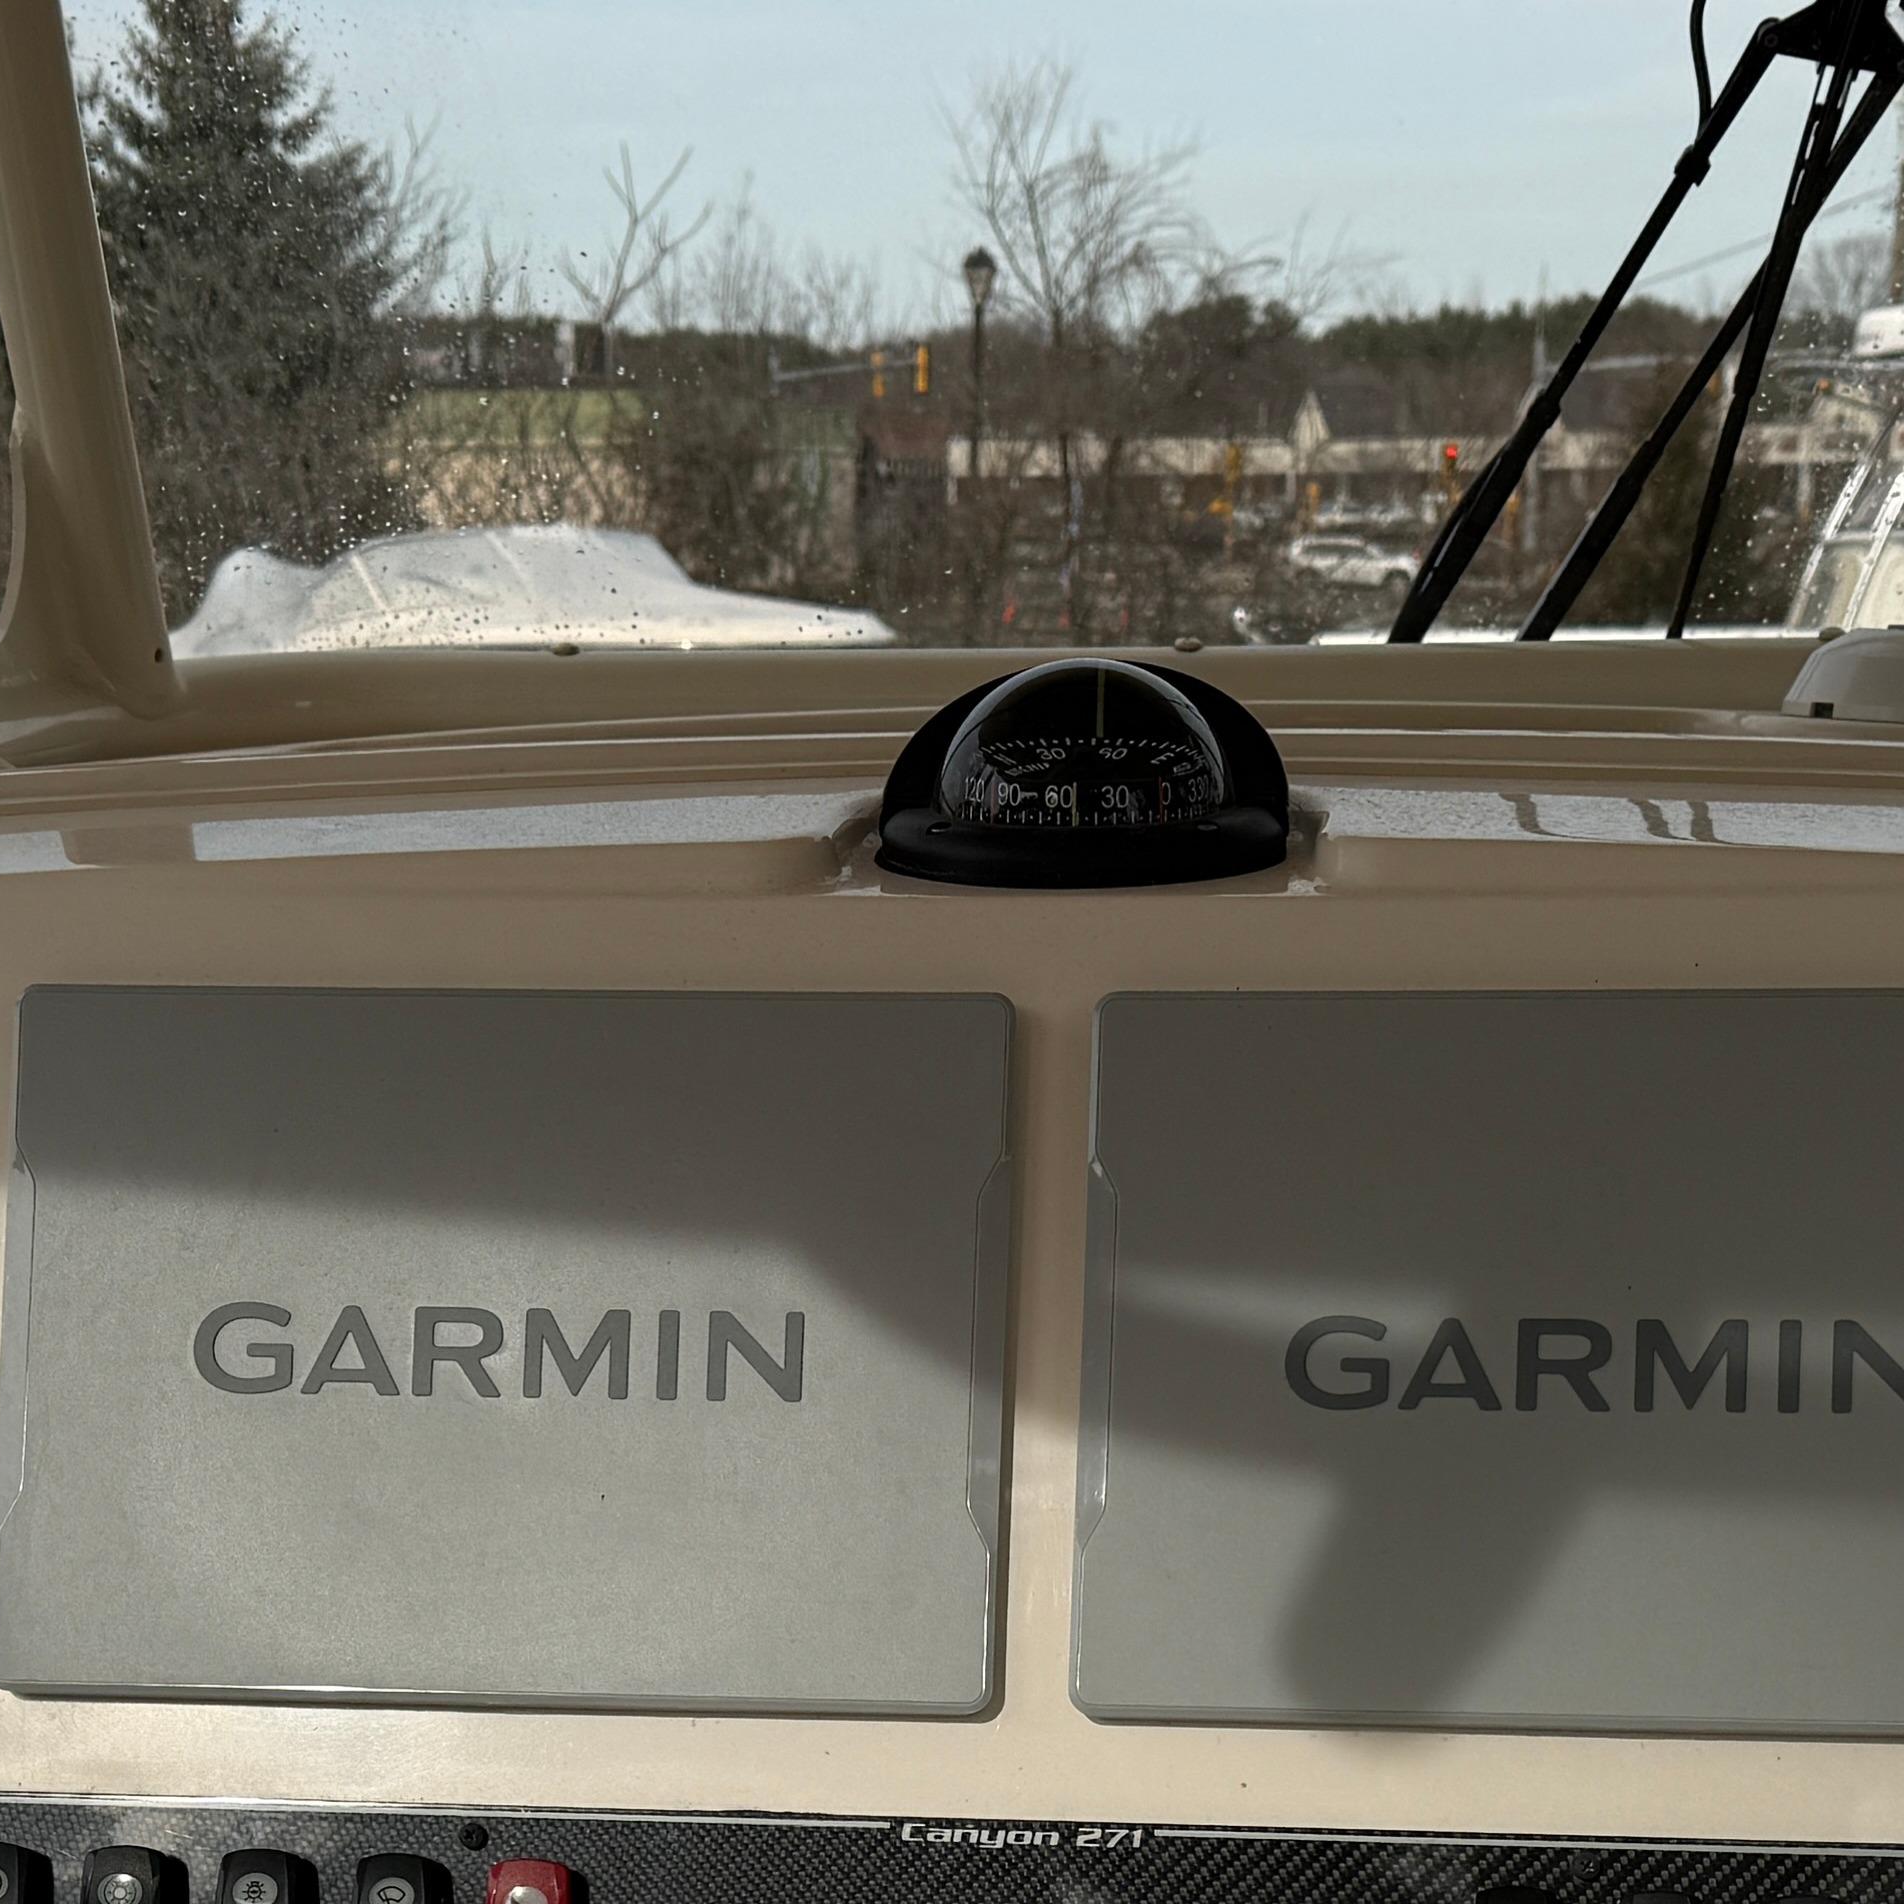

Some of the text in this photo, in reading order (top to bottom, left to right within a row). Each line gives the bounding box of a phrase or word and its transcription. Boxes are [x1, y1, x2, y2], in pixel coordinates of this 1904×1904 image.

[997, 782, 1020, 806] 90
[1045, 785, 1073, 808] 60
[1101, 785, 1129, 808] 30
[193, 1301, 805, 1402] GARMIN
[900, 1822, 1145, 1850] Canyon 271
